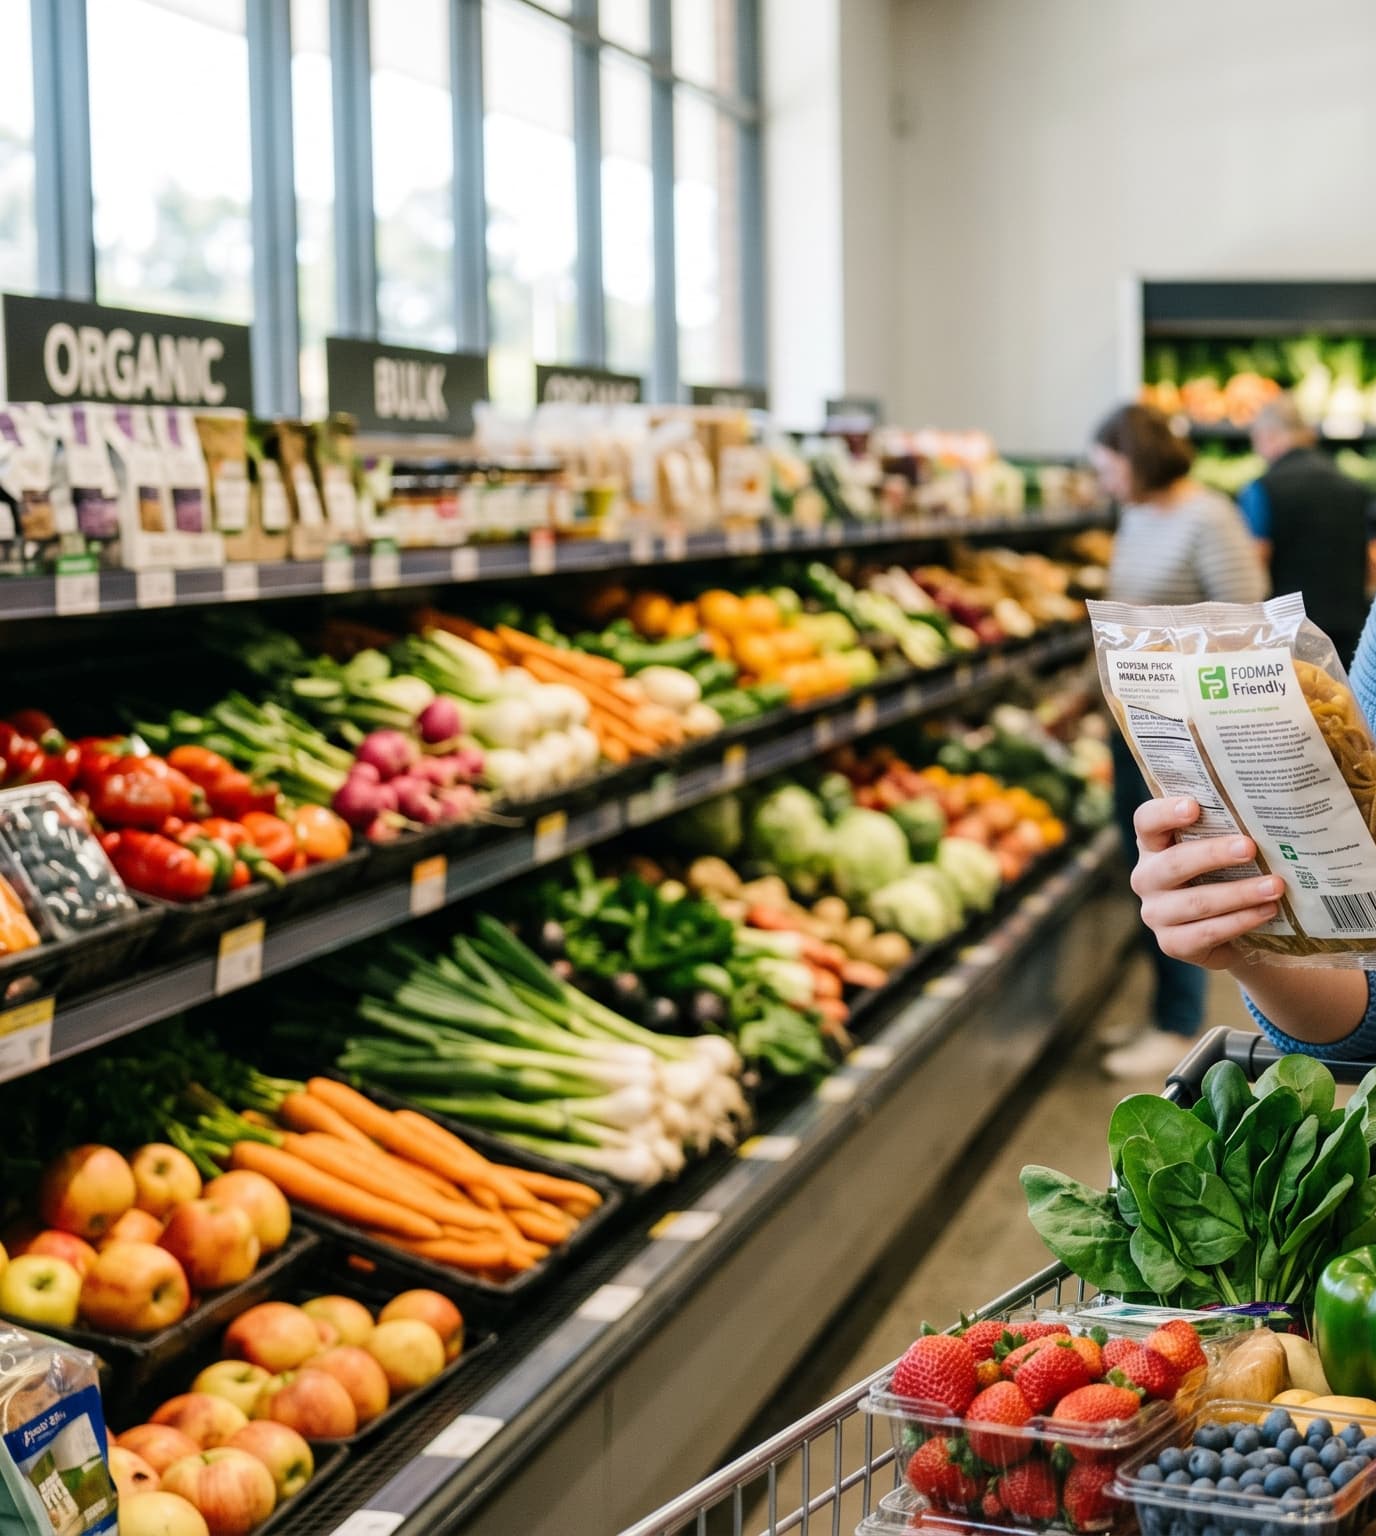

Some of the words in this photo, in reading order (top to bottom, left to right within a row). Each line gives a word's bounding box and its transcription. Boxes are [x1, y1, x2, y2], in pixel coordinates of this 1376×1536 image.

[44, 322, 227, 404] ORGANIC
[373, 356, 448, 421] BULK
[1148, 674, 1176, 682] PASTA
[1231, 663, 1284, 680] FODMAP
[1233, 679, 1287, 696] Friendly
